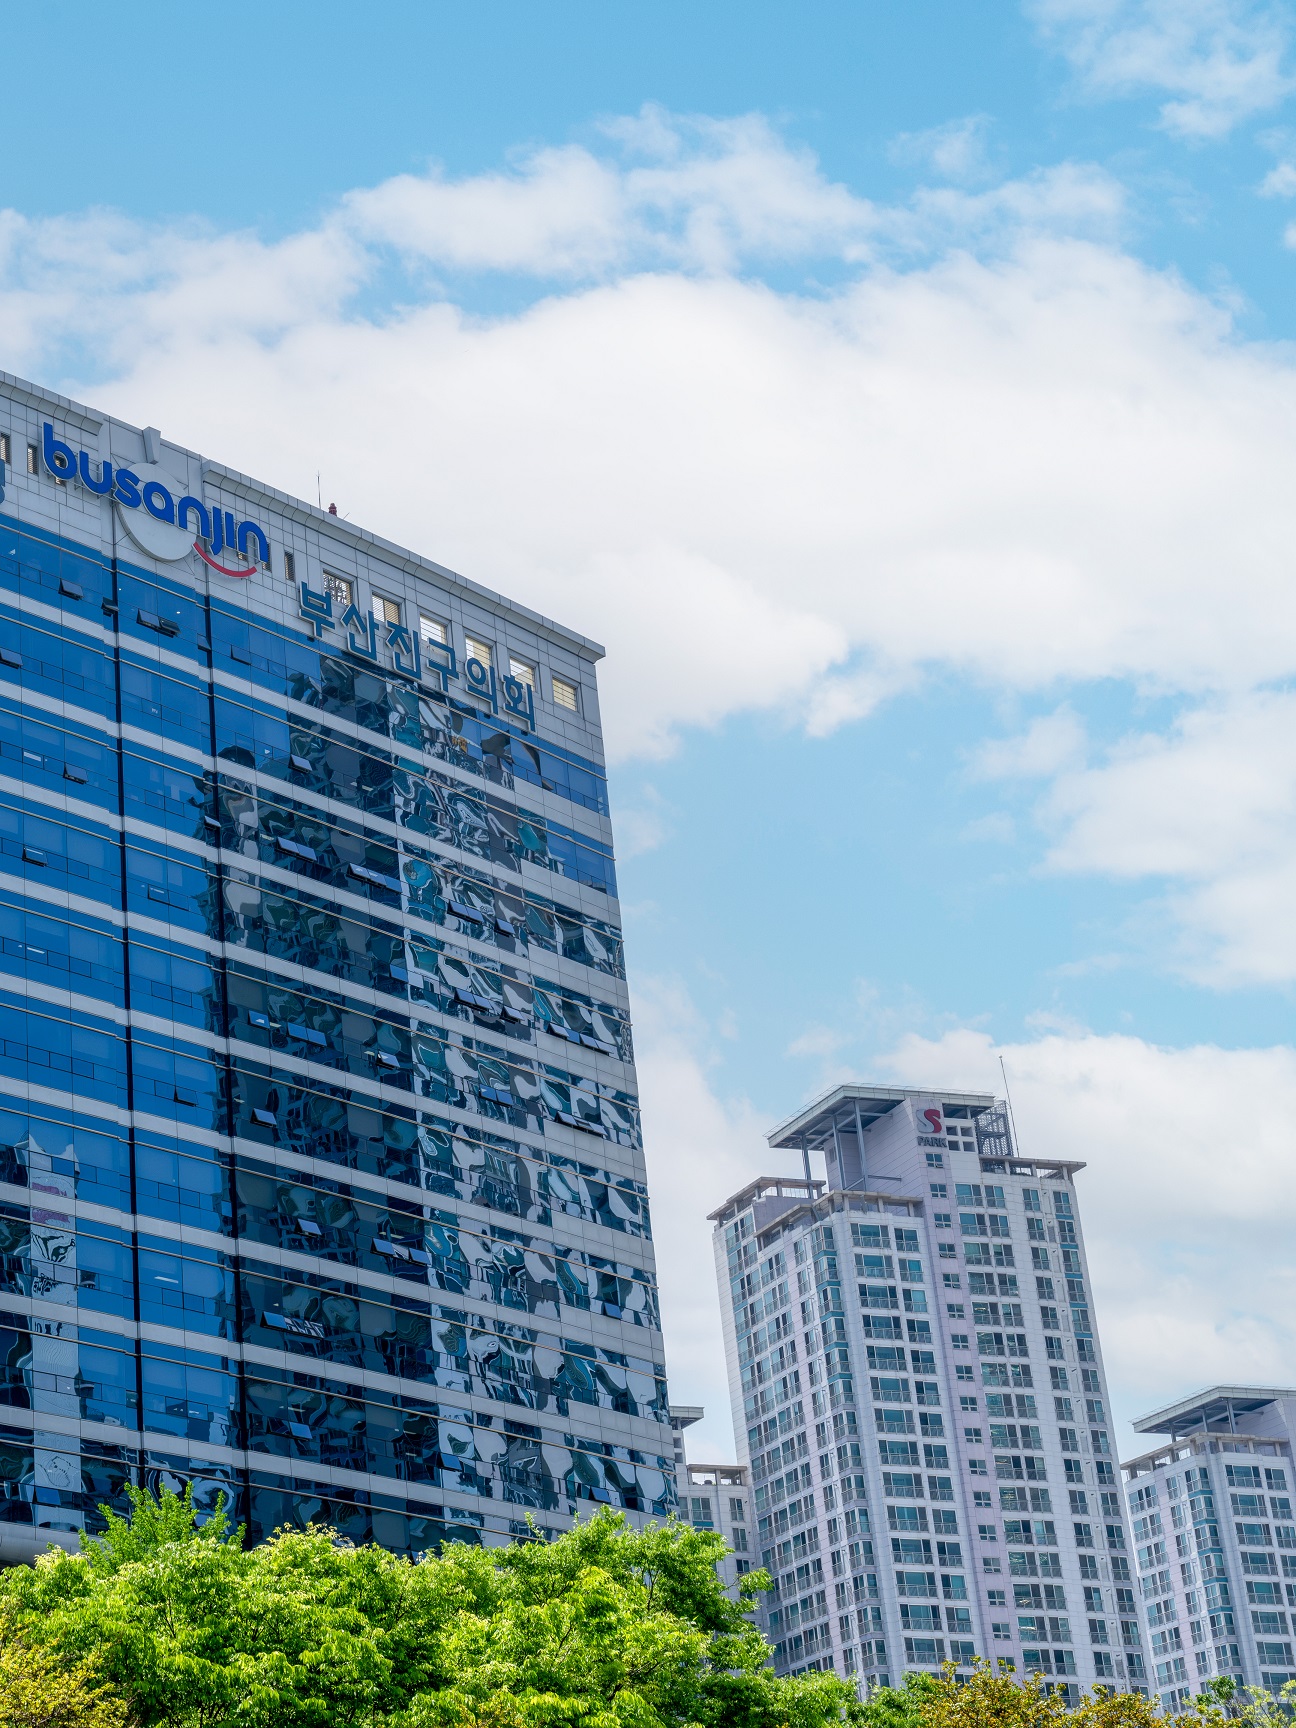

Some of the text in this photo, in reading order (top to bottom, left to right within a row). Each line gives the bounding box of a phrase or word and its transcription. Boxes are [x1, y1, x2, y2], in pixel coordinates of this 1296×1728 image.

[42, 422, 269, 563] busanjin
[298, 580, 536, 732] 부산진구의회
[917, 1136, 947, 1148] PARK
